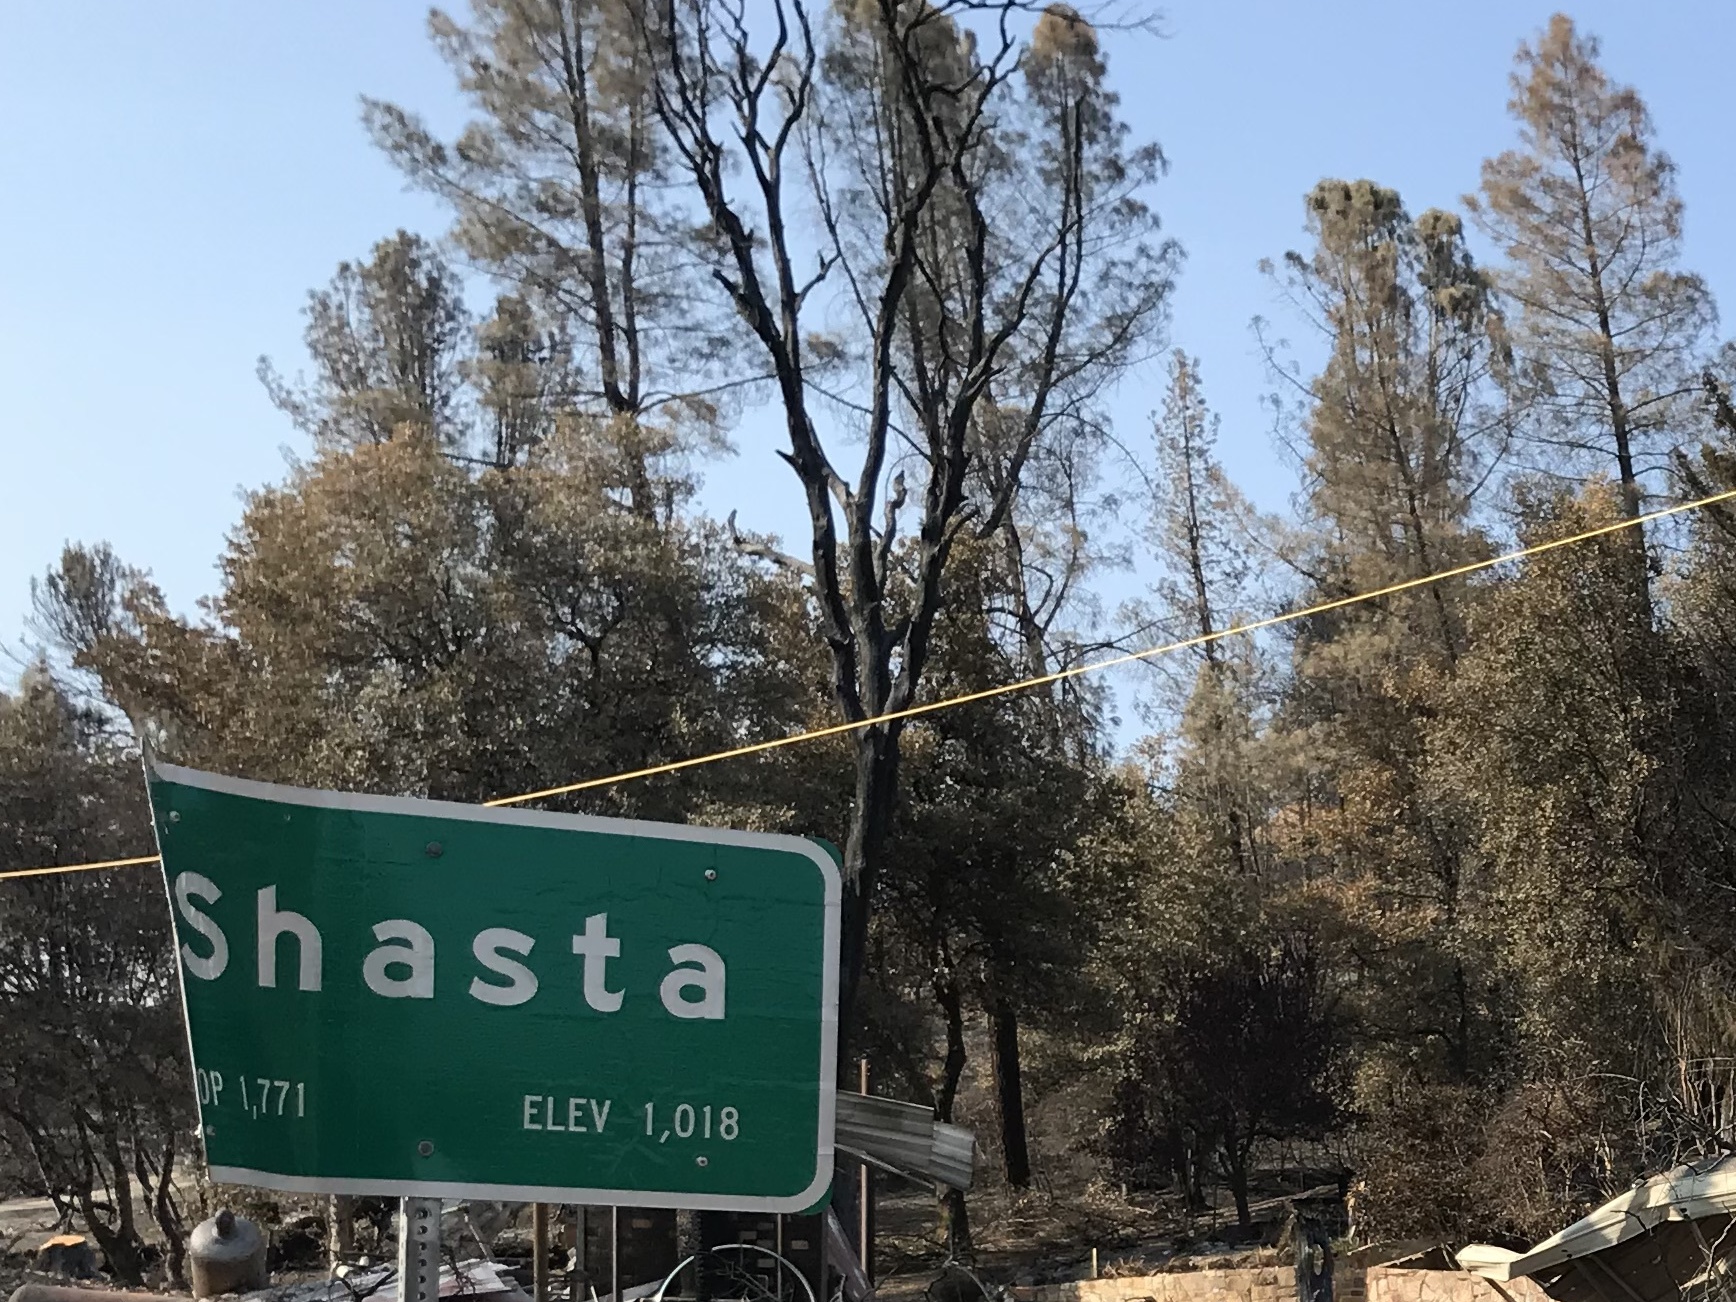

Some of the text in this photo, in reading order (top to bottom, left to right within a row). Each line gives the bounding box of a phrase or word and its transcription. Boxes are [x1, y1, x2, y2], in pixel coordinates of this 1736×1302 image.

[174, 871, 727, 1020] Shasta
[198, 1067, 305, 1120] OP 1,771
[523, 1094, 740, 1143] ELEV 1,018
